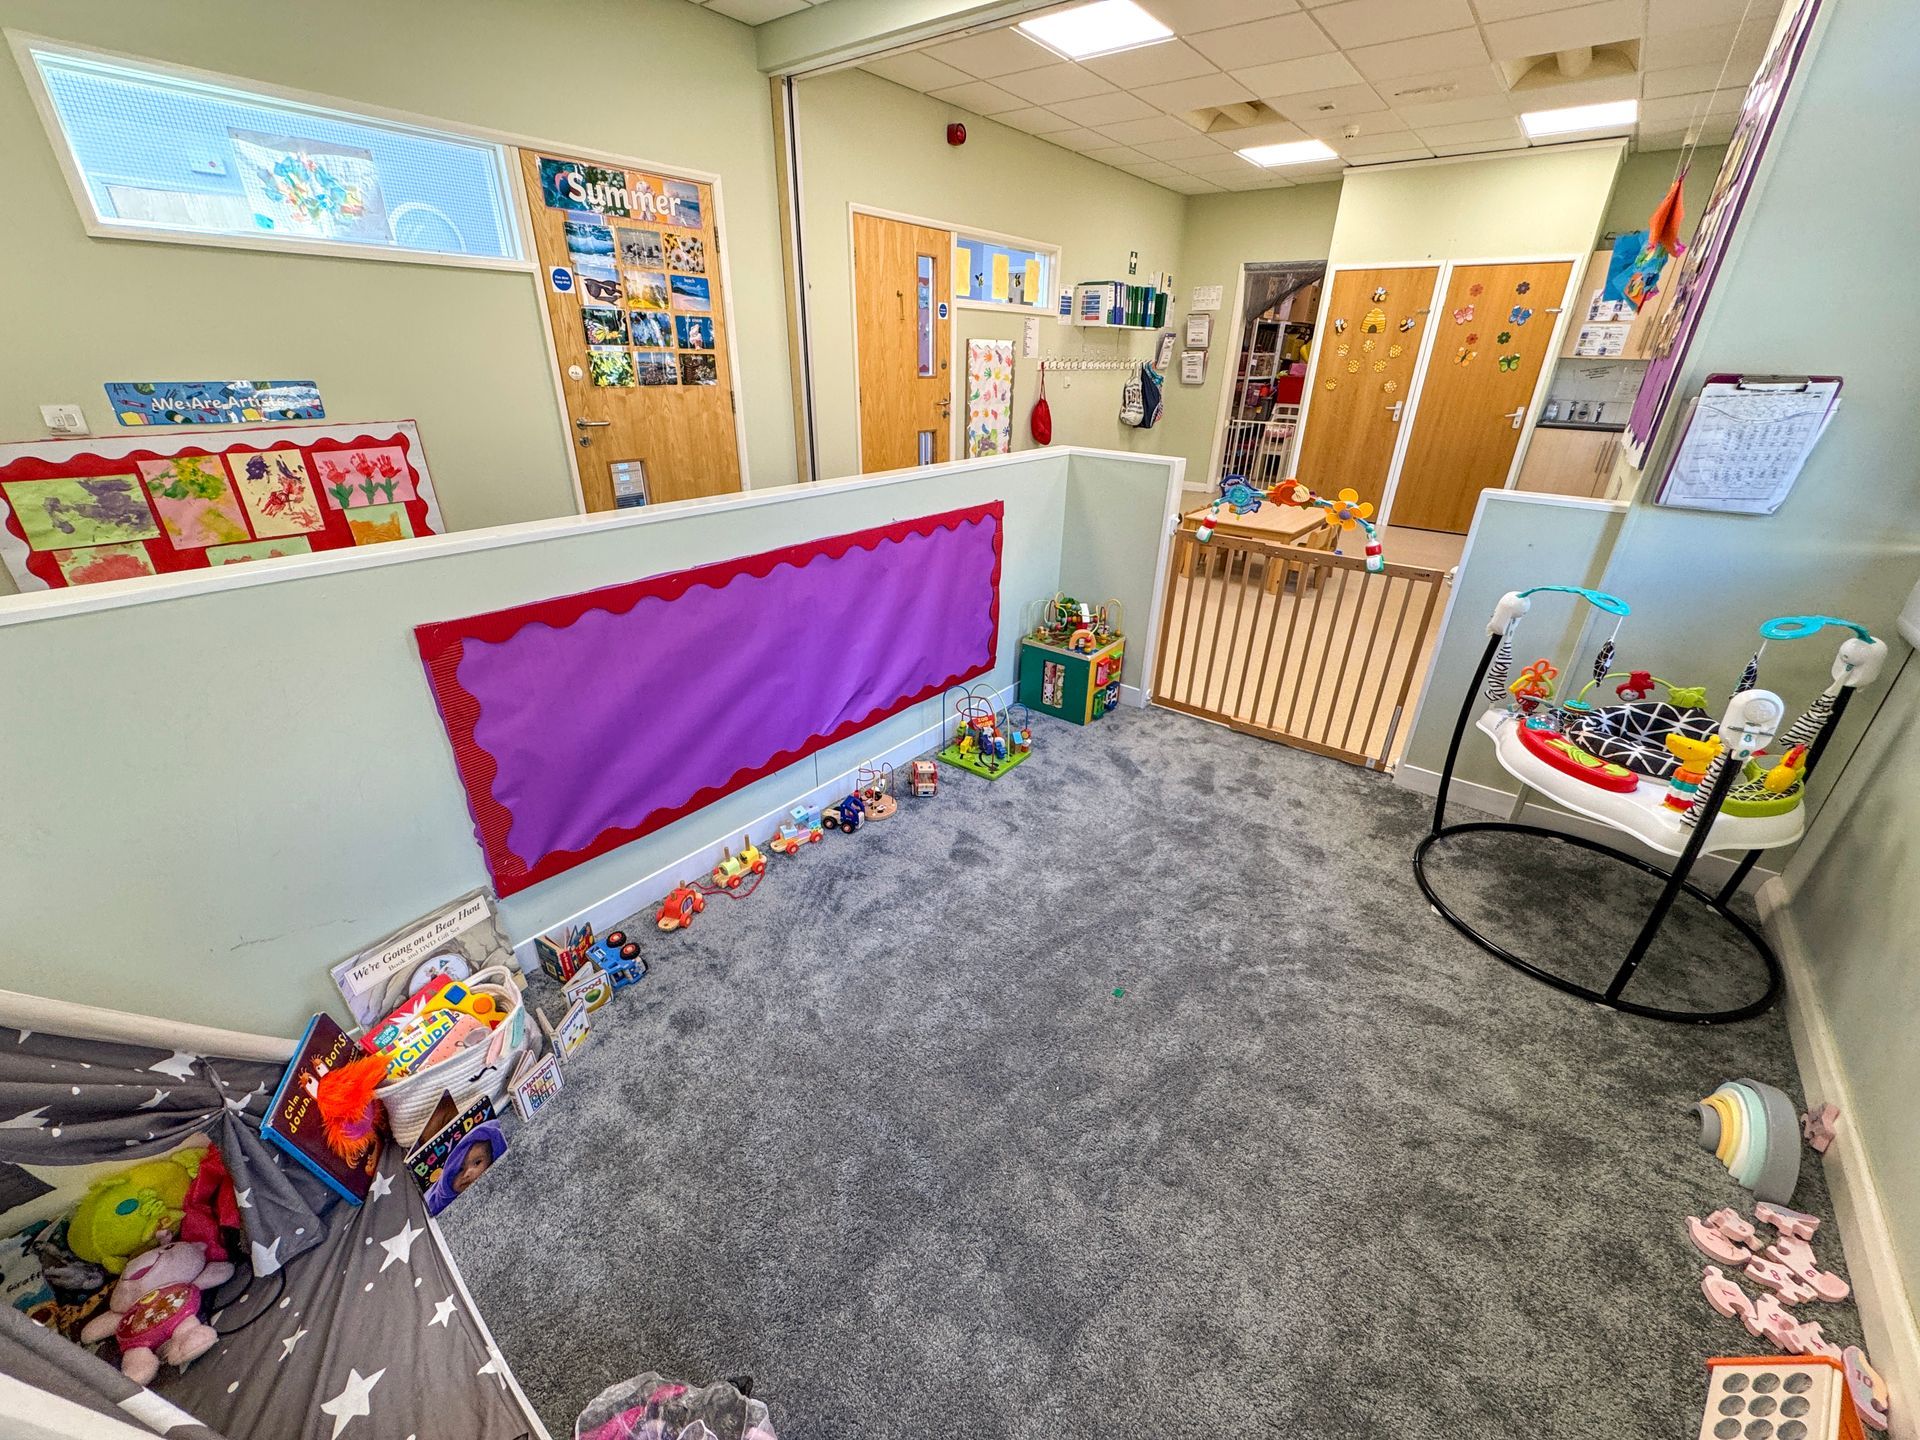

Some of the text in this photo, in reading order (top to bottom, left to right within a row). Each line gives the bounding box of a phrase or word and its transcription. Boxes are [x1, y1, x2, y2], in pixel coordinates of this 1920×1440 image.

[568, 171, 681, 217] Summer
[153, 396, 286, 411] We Are Artists
[353, 902, 481, 982] We're Going on a Bear Hunt
[388, 958, 405, 972] Book
[407, 949, 419, 961] and
[420, 939, 437, 953] DVD
[575, 978, 602, 996] Food
[561, 1005, 584, 1035] Counting
[325, 1031, 348, 1067] Boris!
[521, 1060, 554, 1094] Alphabet
[284, 1095, 300, 1119] Calm
[463, 1105, 491, 1133] Day
[410, 1154, 421, 1165] MY
[425, 1134, 444, 1152] FIRST
[447, 1115, 465, 1133] BABY
[6, 1270, 41, 1293] Giraff
[1770, 1269, 1781, 1280] 8
[1768, 1313, 1780, 1321] 5
[1856, 1369, 1873, 1388] 10
